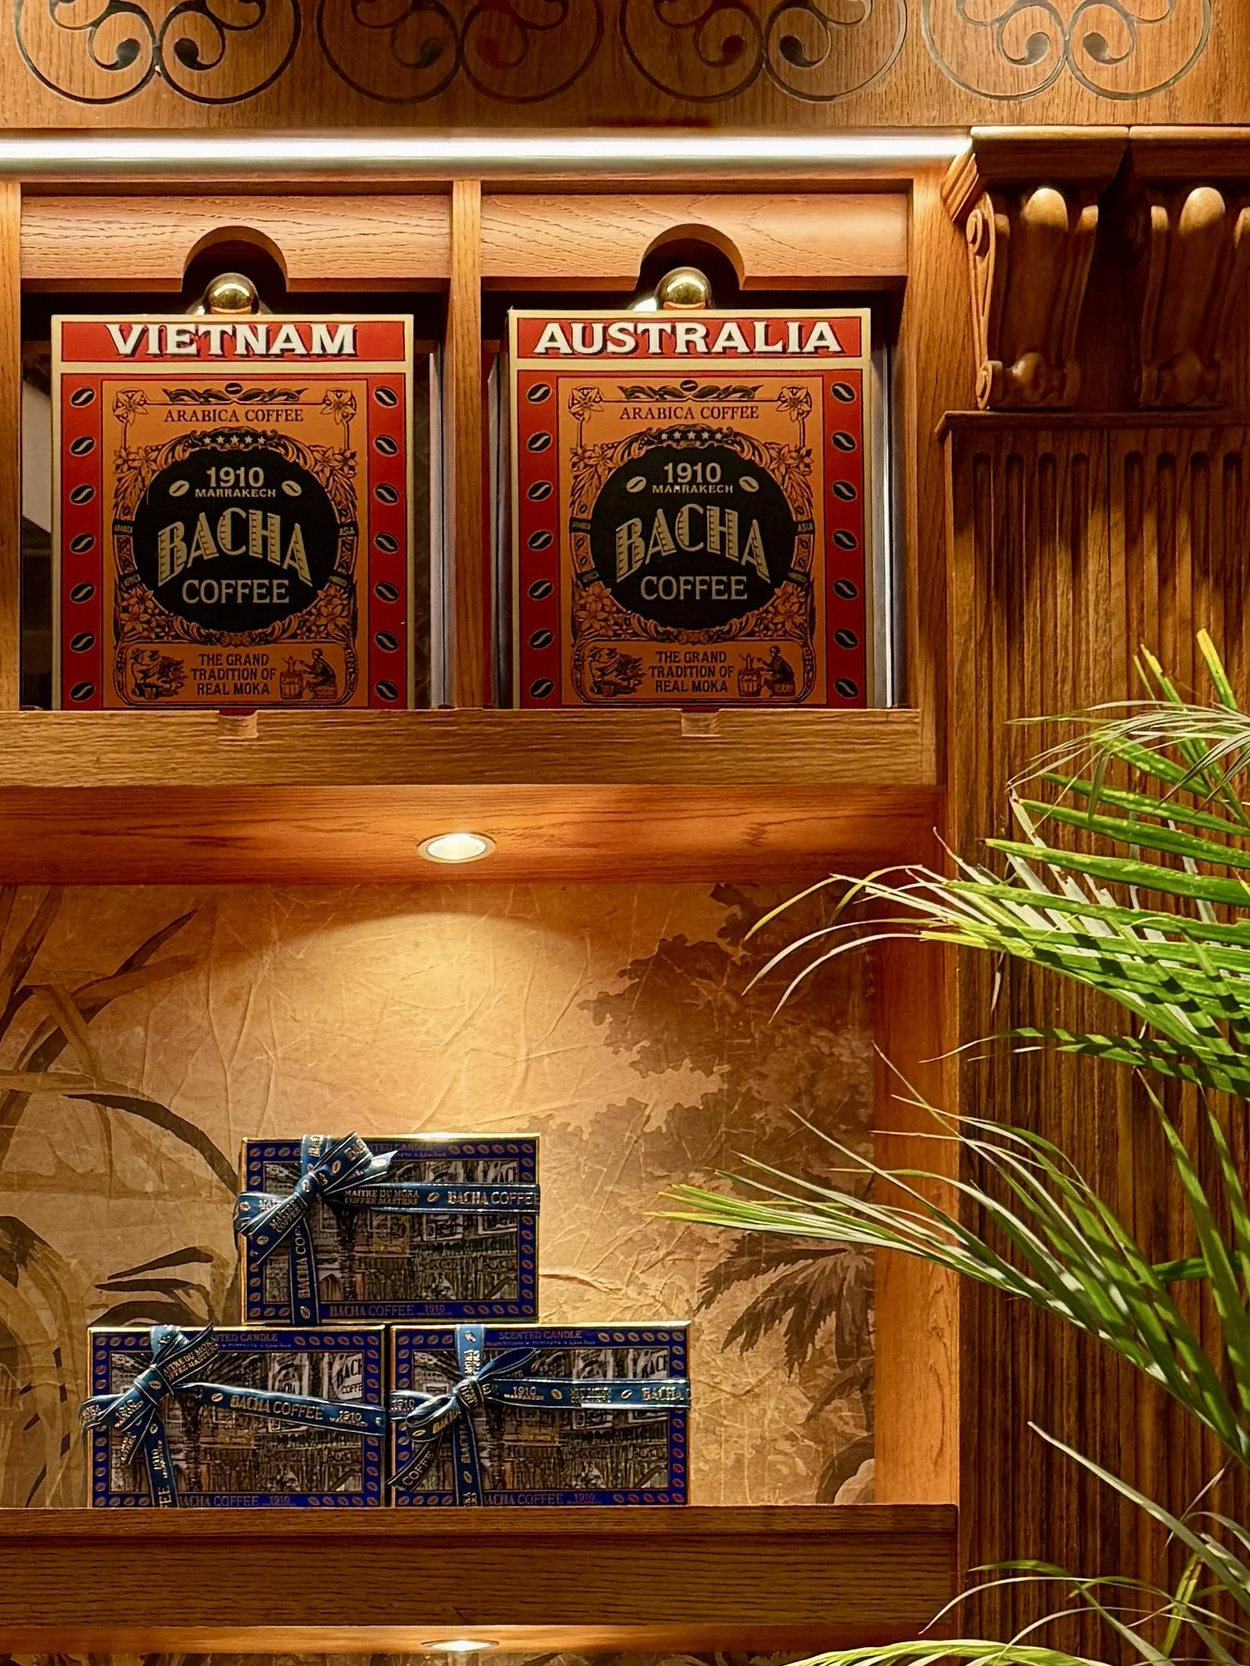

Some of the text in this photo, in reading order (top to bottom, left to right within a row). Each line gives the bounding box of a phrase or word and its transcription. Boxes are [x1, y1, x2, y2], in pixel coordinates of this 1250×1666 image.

[104, 323, 357, 358] VIETNAM
[533, 321, 845, 354] AUSTRALIA
[164, 408, 304, 423] ARABICA COFFEE
[619, 405, 760, 420] ARABICA COFFEE
[206, 467, 264, 488] 1910
[663, 462, 722, 484] 1910
[194, 488, 276, 498] MARRAKECH
[652, 484, 733, 494] MARRAKECH
[157, 507, 312, 588] BACHA
[615, 503, 771, 584] BACHA
[181, 579, 290, 605] COFFEE
[640, 575, 748, 601] COFFEE
[198, 653, 269, 666] THE GRAND
[656, 651, 727, 664] THE GRAND
[191, 668, 276, 681] TRADITION OF
[648, 665, 734, 678] TRADITION OF
[197, 682, 270, 695] REAL MOKA
[655, 679, 728, 693] REAL MOKA
[330, 1305, 366, 1316] BACHA
[369, 1305, 414, 1316] COFFEE
[543, 1331, 582, 1339] CANDLE
[230, 1395, 270, 1413] BACHA
[273, 1402, 323, 1421] COFFEE
[214, 1496, 259, 1507] COFFEE
[518, 1494, 563, 1505] COFFEE
